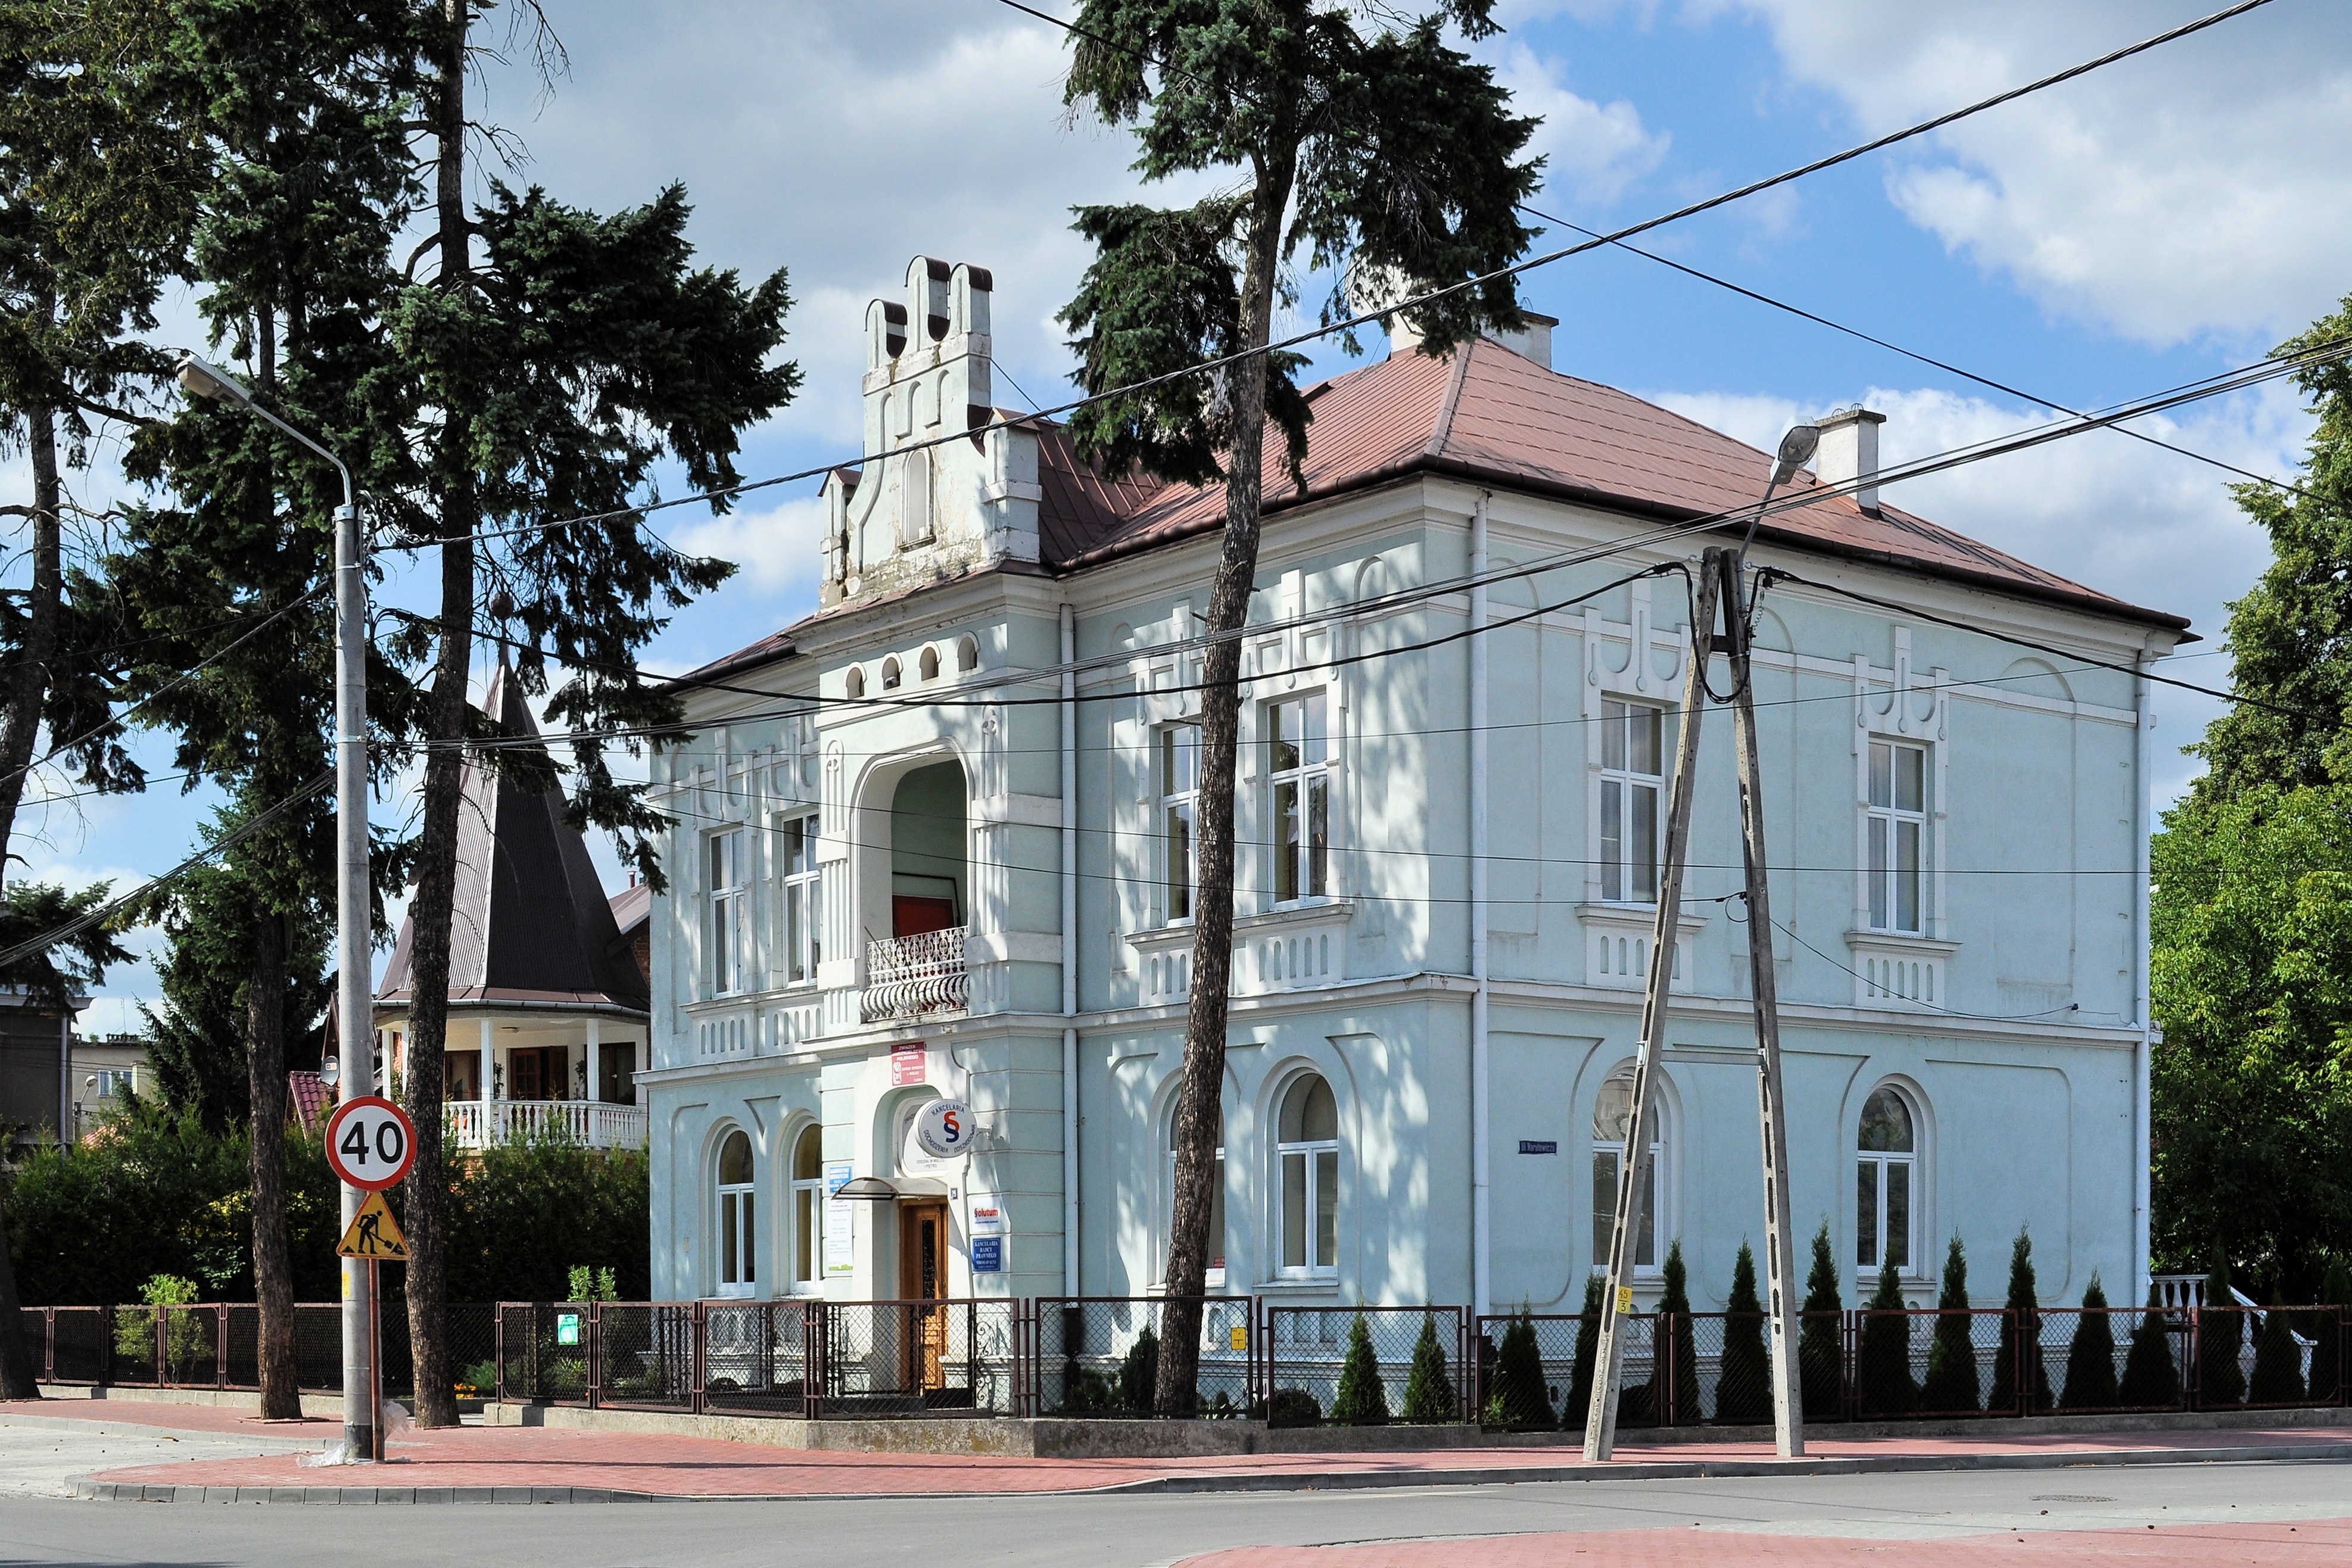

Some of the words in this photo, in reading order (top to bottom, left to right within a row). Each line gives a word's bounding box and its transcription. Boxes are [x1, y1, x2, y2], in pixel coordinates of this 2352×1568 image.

[931, 1104, 965, 1117] KANCELARIA
[341, 1121, 404, 1165] 40
[923, 1129, 949, 1154] DOCHODZENIA
[954, 1124, 976, 1153] ODSZKODOWAŃ
[1619, 1289, 1628, 1299] 45
[1621, 1302, 1626, 1312] 3
